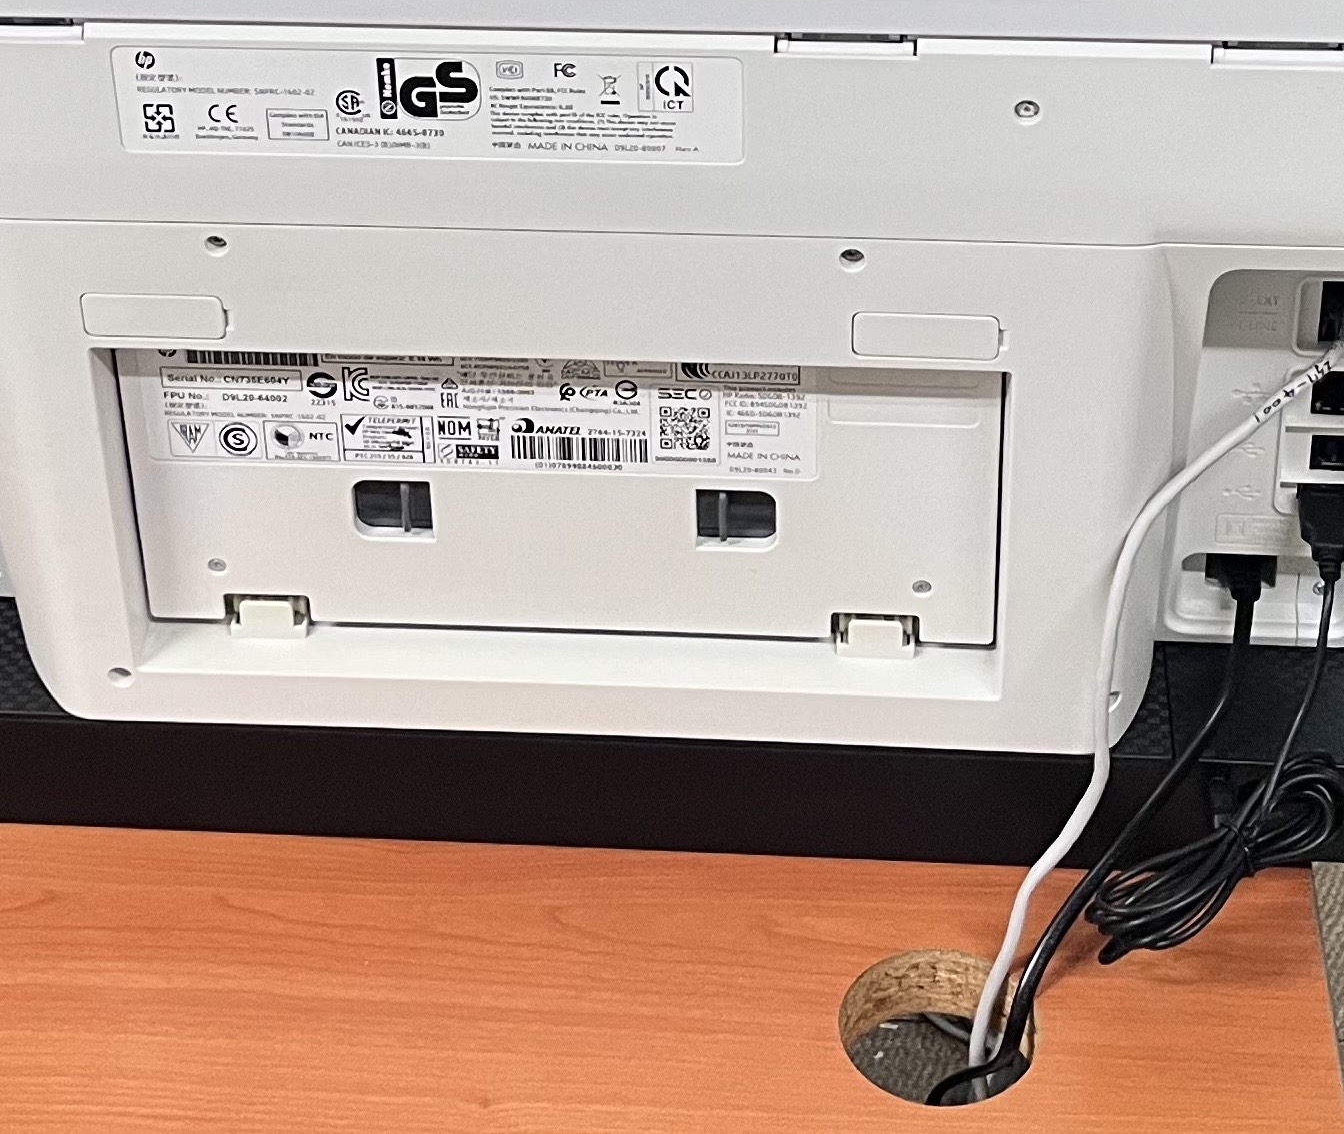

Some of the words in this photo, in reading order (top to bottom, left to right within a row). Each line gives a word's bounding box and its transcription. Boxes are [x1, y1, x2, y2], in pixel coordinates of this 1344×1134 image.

[135, 50, 156, 70] hp
[399, 61, 479, 118] GS
[663, 100, 685, 110] ICT
[336, 127, 381, 136] CANADIAN
[527, 142, 557, 150] MADE
[560, 142, 573, 150] IN
[574, 143, 609, 151] CHINA
[167, 374, 198, 383] Serial
[163, 391, 185, 400] FPU
[437, 420, 472, 436] NOM
[535, 426, 582, 435] ANATEL
[309, 432, 334, 441] NTC
[727, 452, 754, 460] MADE
[757, 452, 768, 460] IN
[769, 453, 801, 461] CHINA
